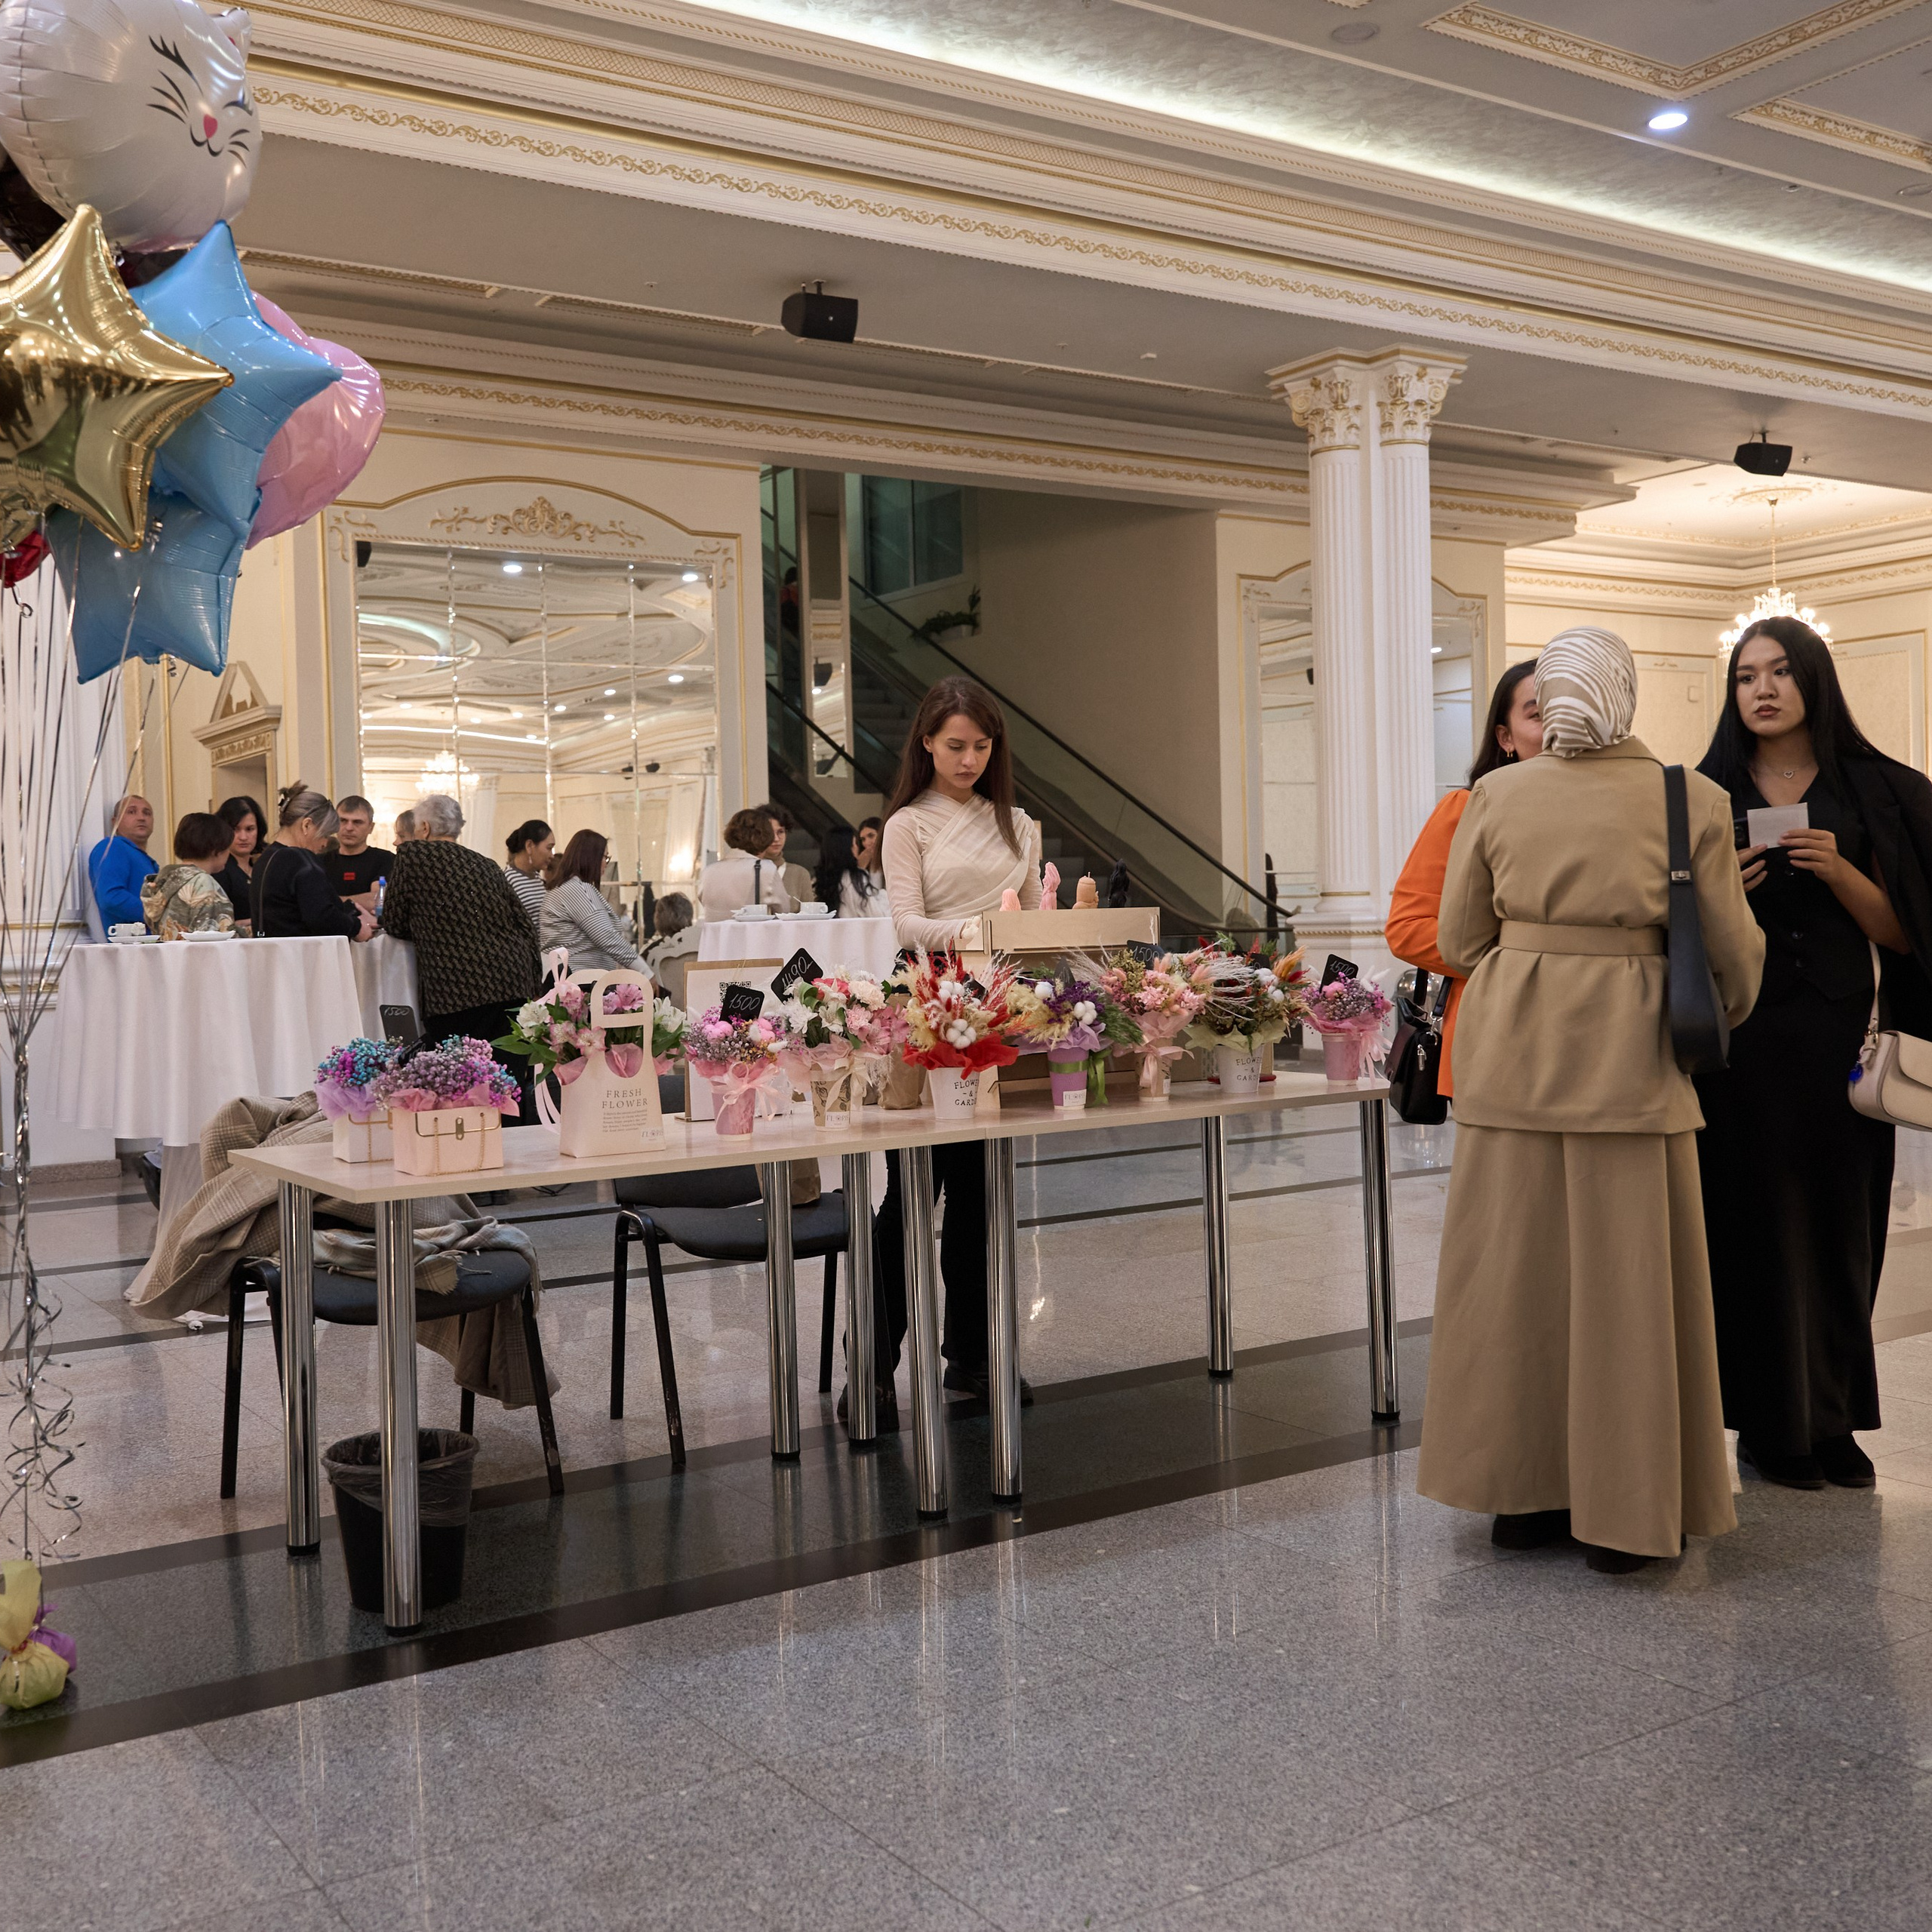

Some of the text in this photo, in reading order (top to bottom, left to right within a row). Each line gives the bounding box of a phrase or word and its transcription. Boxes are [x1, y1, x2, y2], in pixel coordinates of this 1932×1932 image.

[728, 993, 761, 1011] 1500
[606, 1088, 641, 1098] FRESH
[601, 1098, 648, 1109] FLOWER
